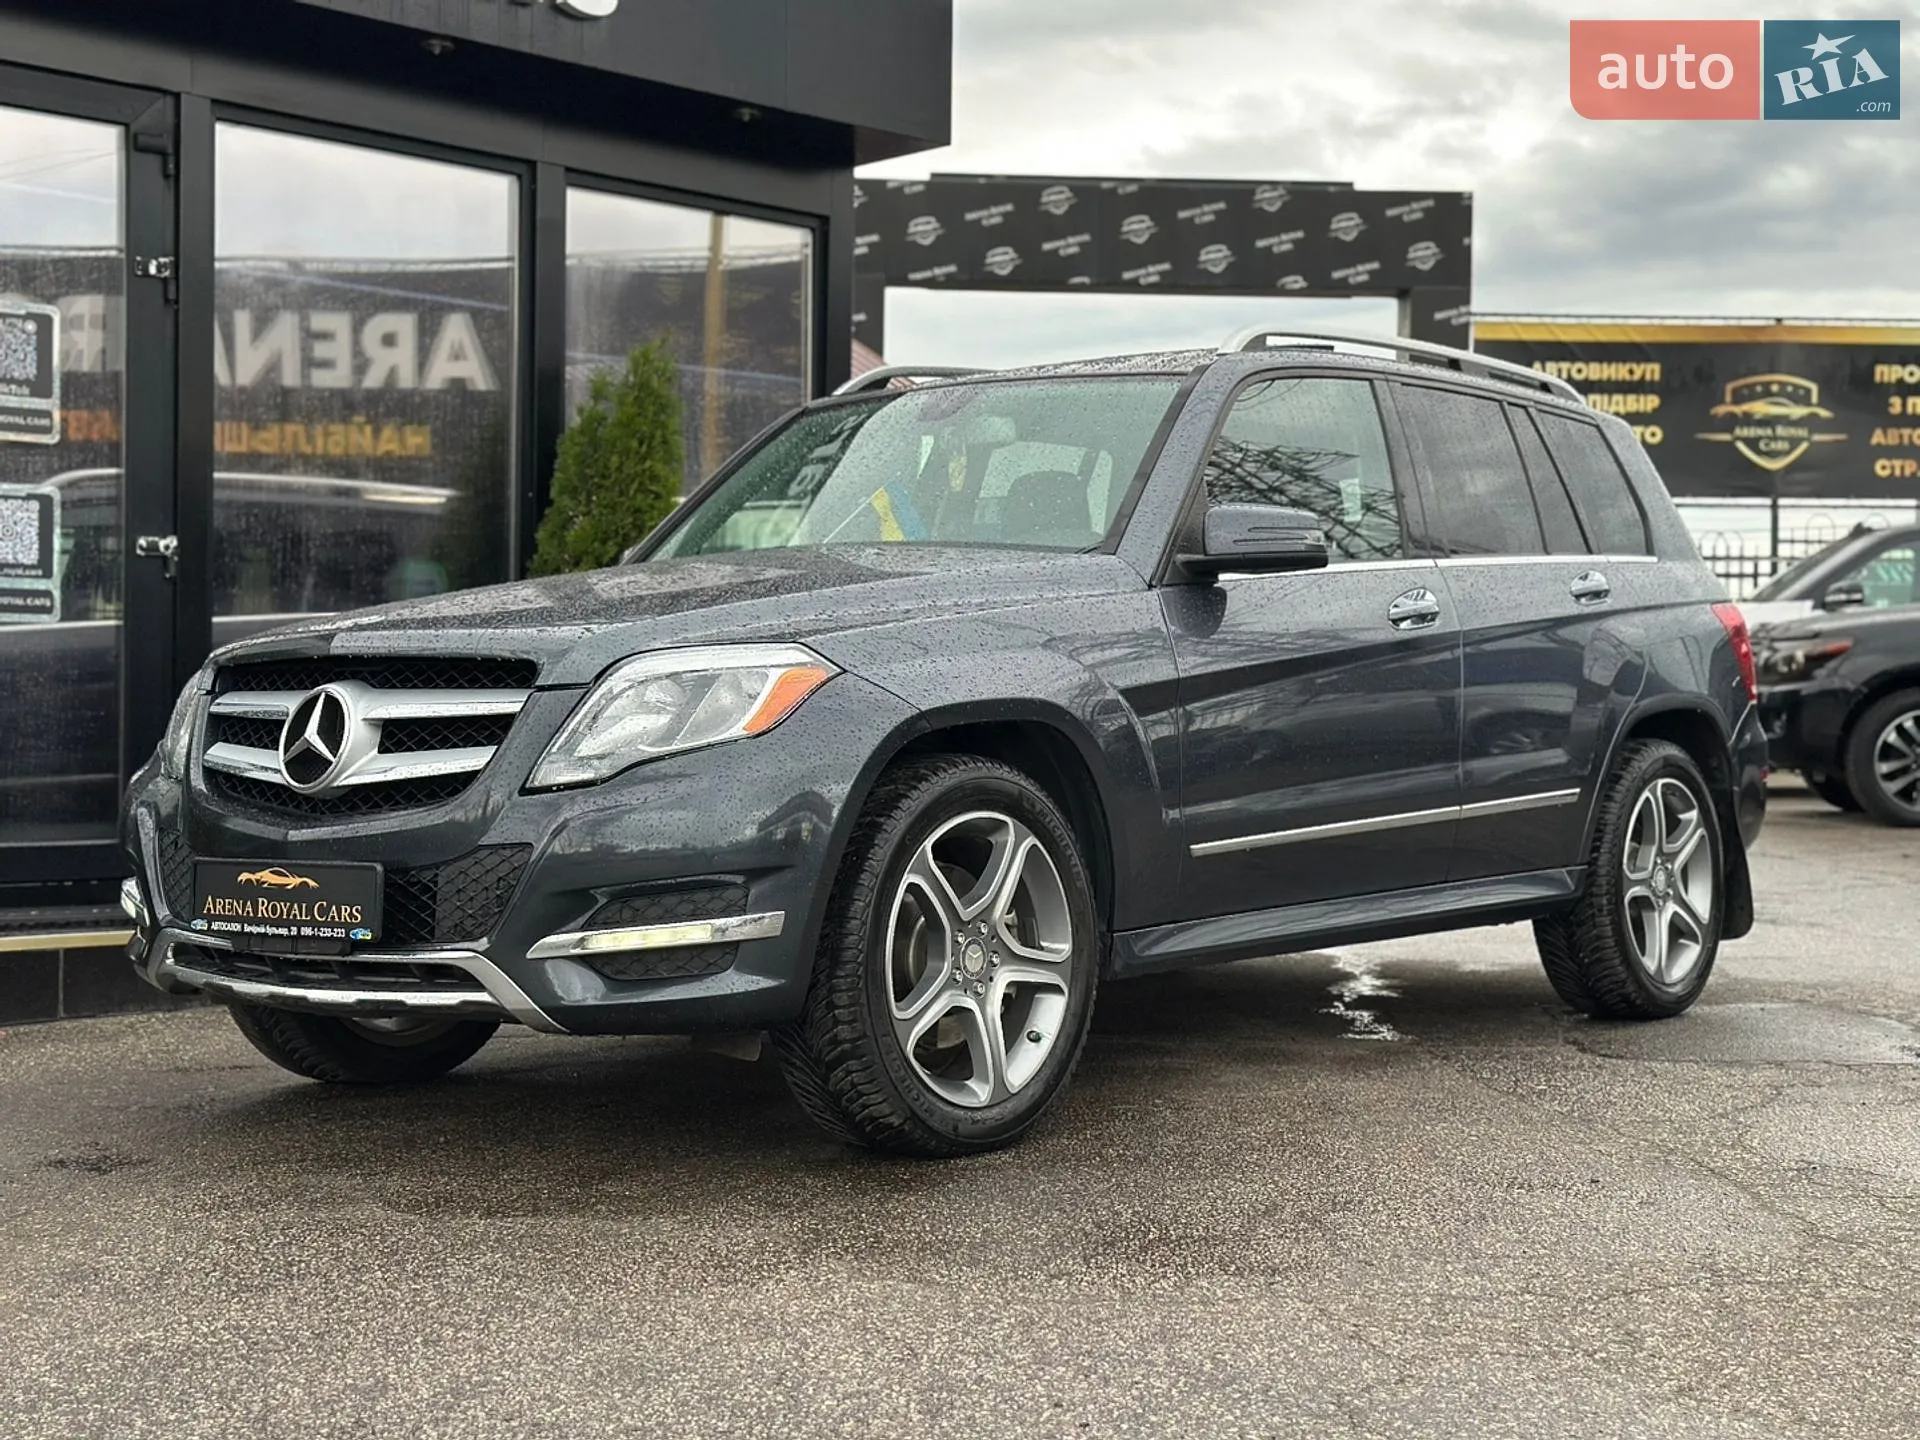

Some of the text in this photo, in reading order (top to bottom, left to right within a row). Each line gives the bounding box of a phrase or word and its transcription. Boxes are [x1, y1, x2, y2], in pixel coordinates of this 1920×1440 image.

[1532, 360, 1661, 382] АВТОВИКУП
[1581, 392, 1661, 415] ПІДБІР
[1873, 457, 1920, 479] СТР
[203, 894, 362, 924] ARENA ROYAL CARS
